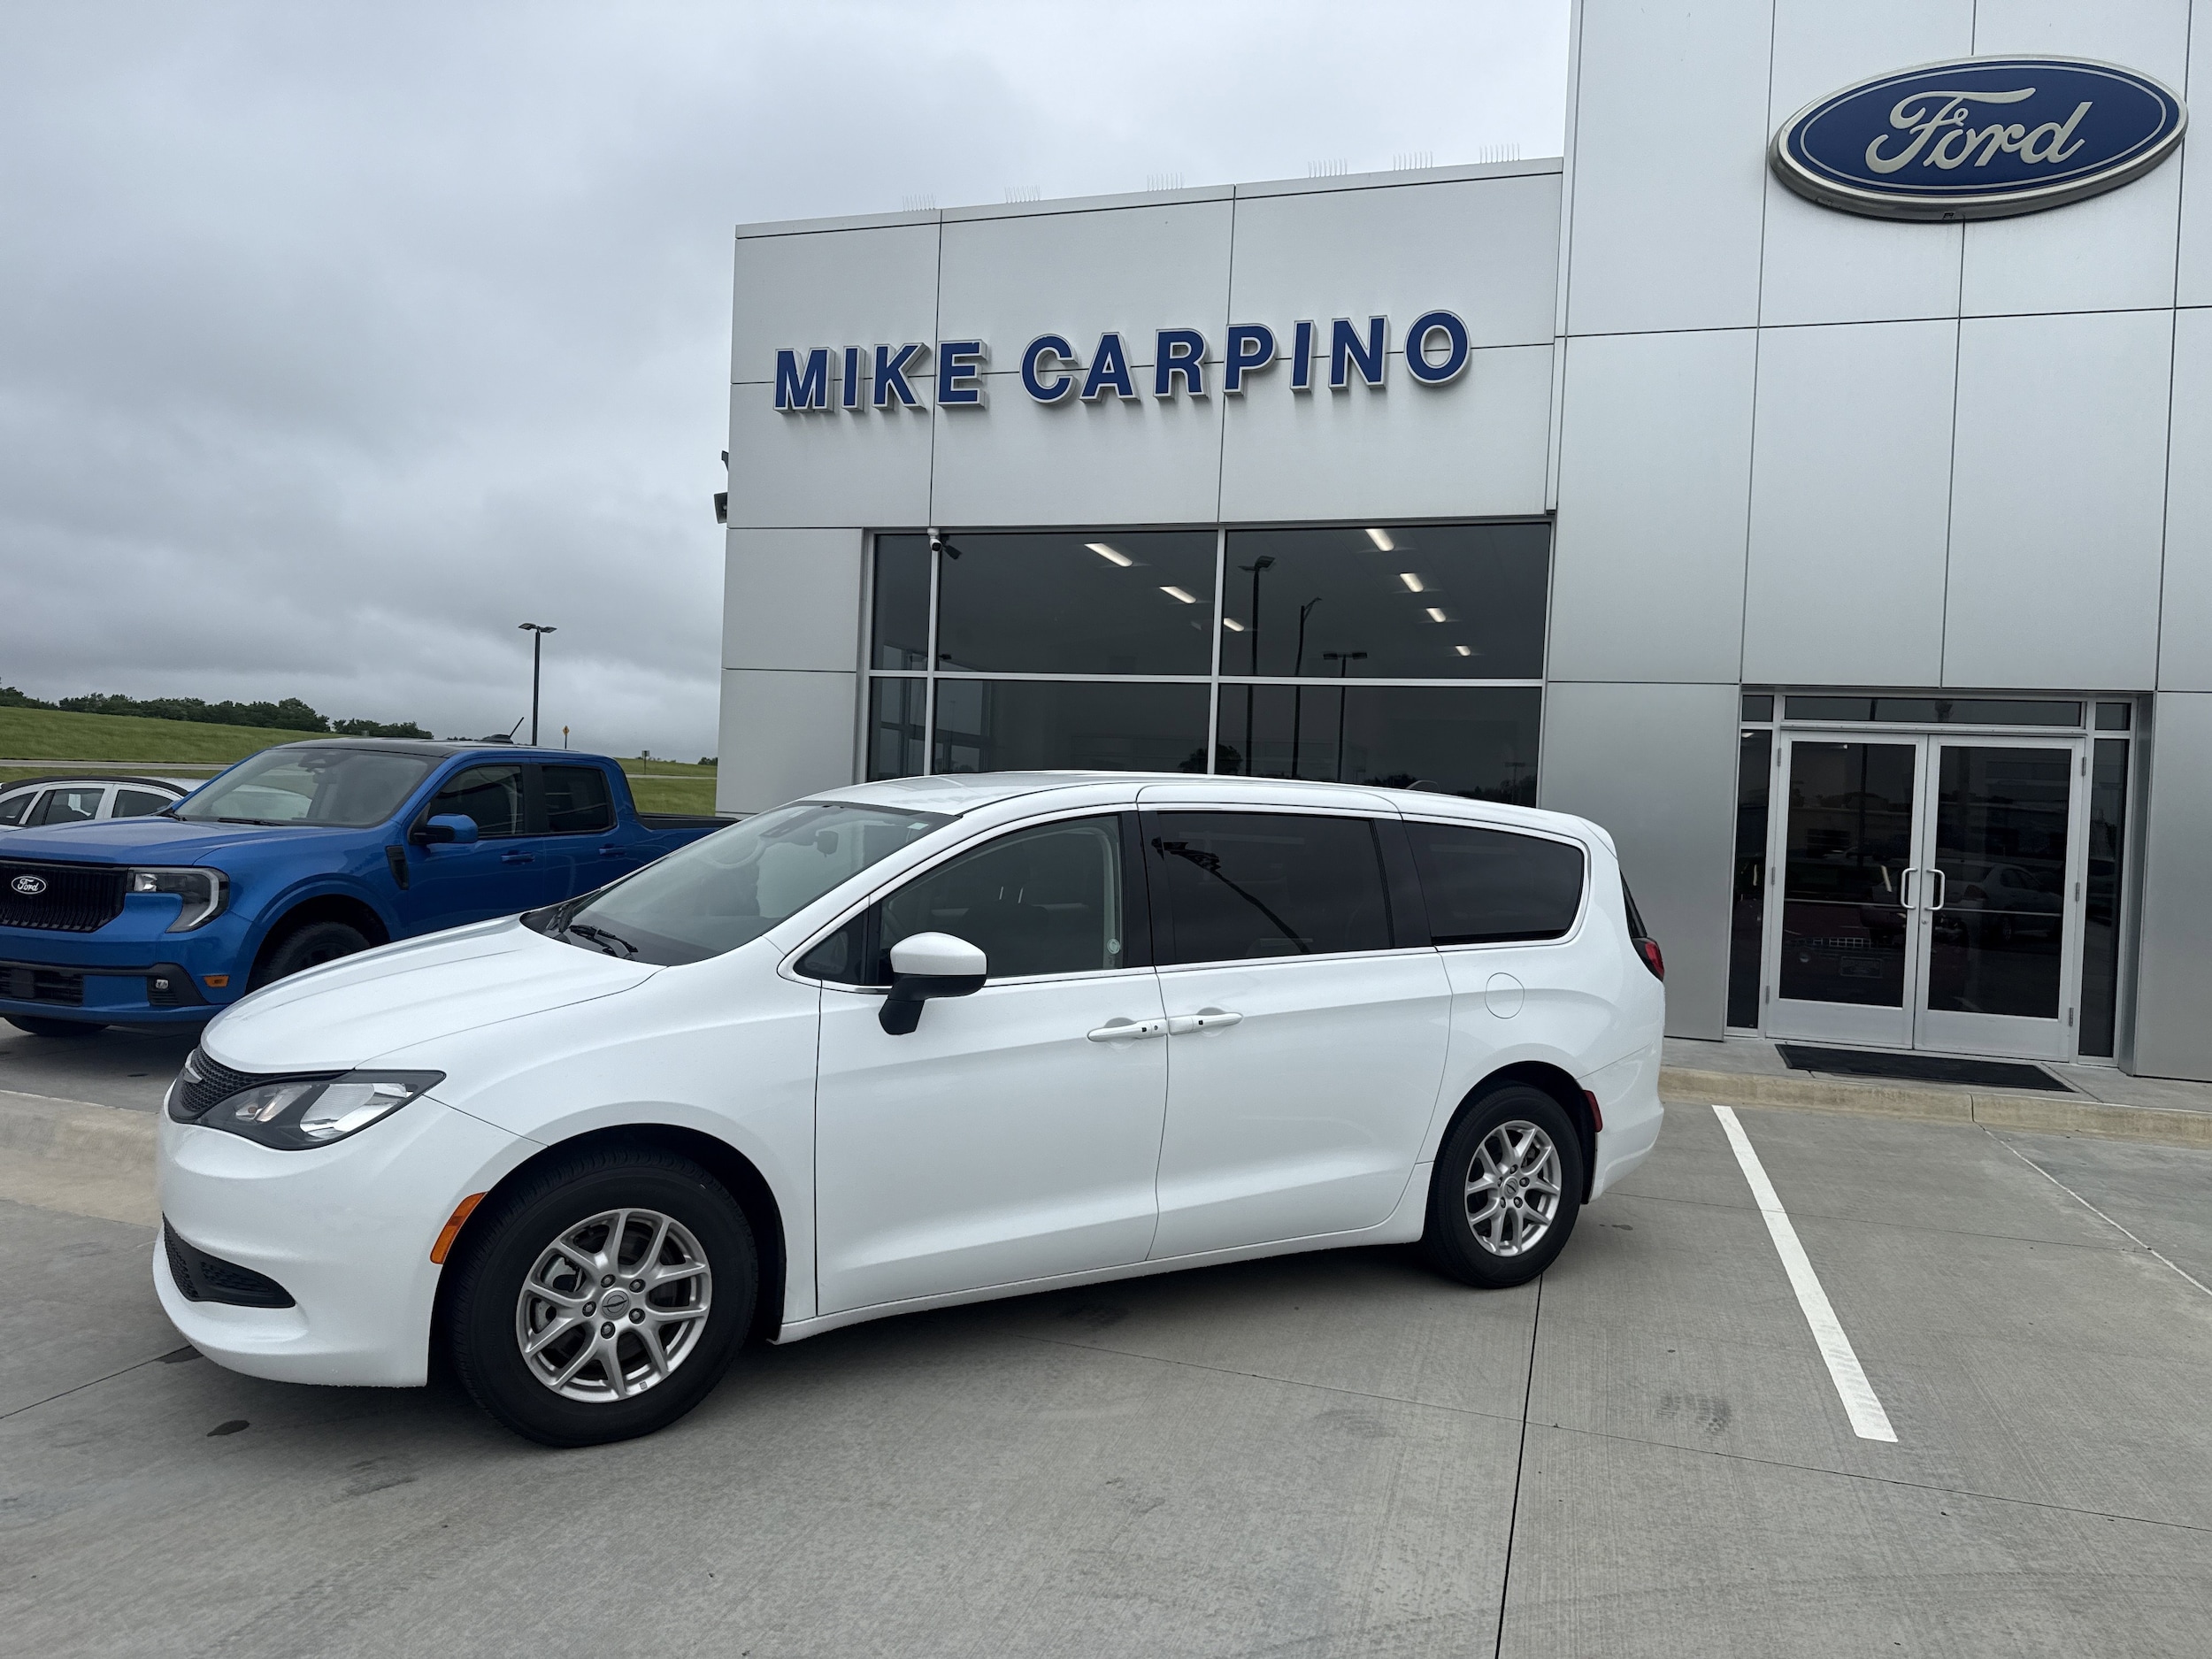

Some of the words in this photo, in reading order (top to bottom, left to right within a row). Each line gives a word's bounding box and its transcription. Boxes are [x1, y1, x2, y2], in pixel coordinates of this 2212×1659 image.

[1865, 87, 2093, 174] Ford
[773, 340, 986, 412] MIKE
[1020, 311, 1471, 404] CARPINO
[18, 879, 39, 891] Ford
